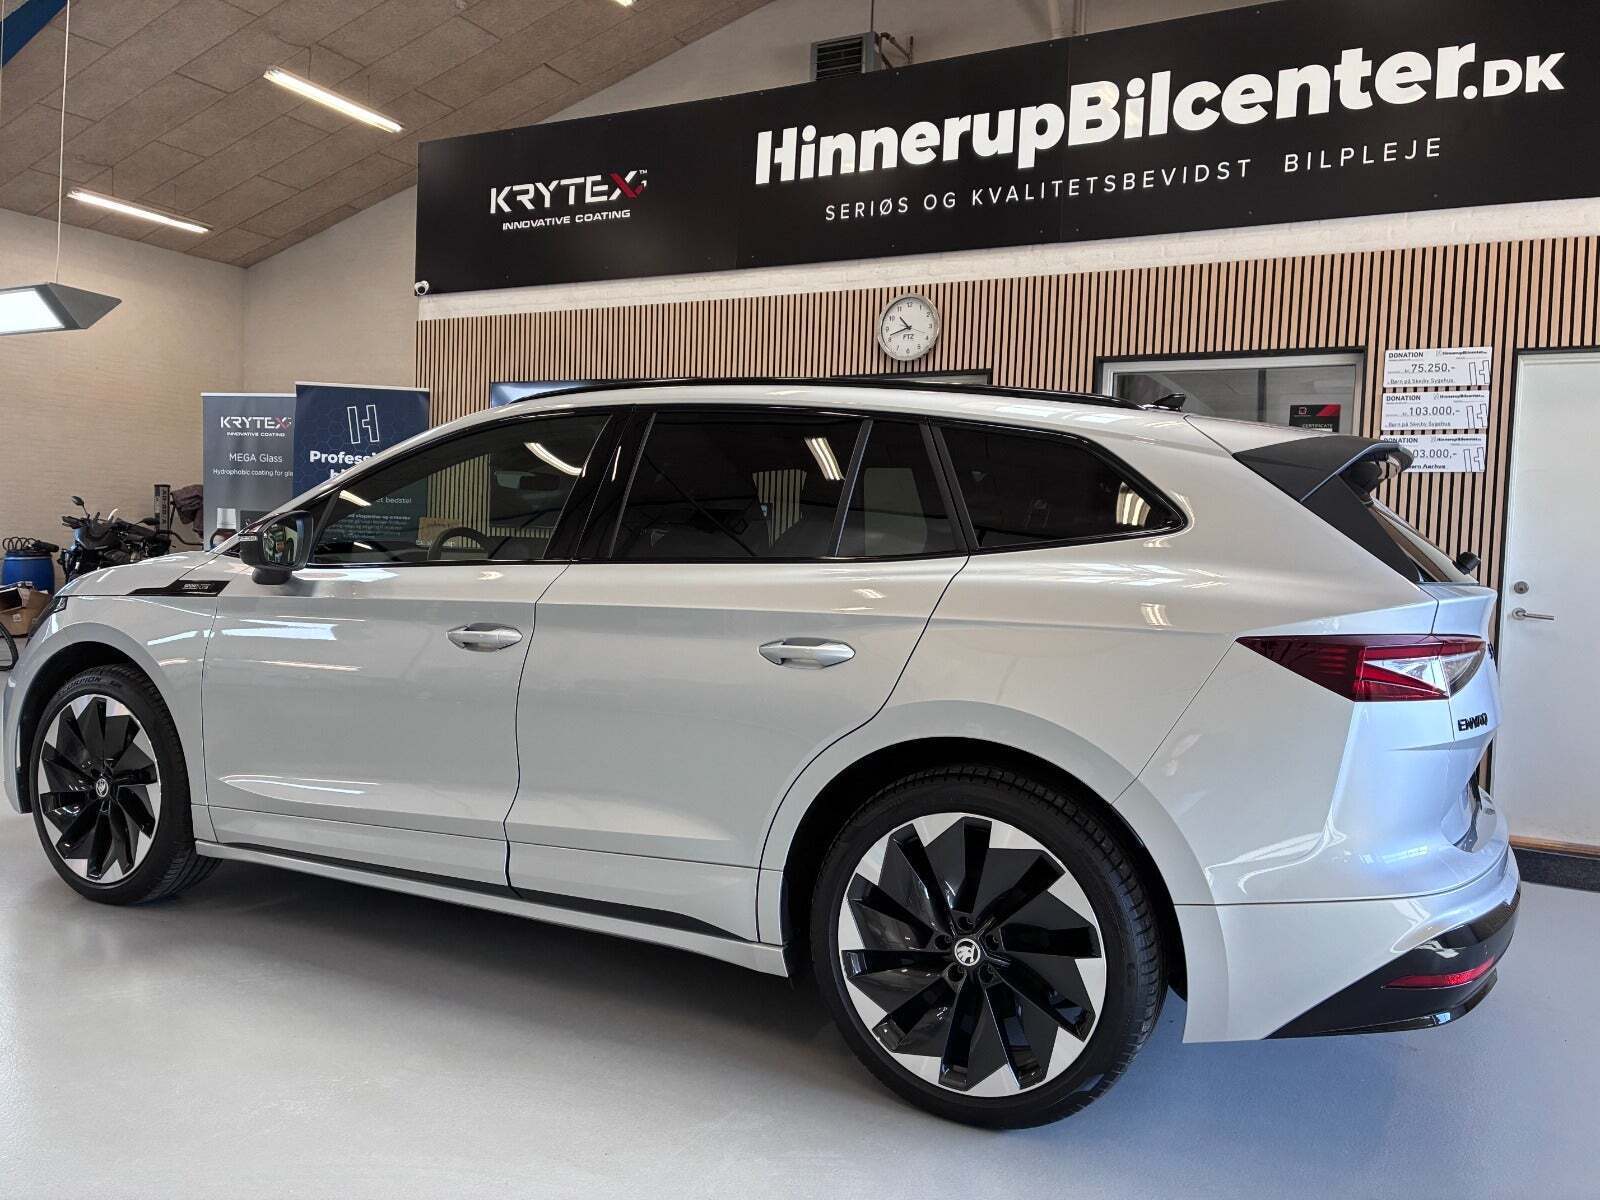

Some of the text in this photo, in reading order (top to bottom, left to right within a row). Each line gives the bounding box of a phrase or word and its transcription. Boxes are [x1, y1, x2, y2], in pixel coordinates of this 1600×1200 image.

[755, 42, 1565, 185] HinnerupBilcenter.DK
[825, 137, 1441, 221] SERIØS OG KVALITETSBEVIDST BILPLEJE
[490, 170, 647, 214] KRYTEX
[502, 209, 631, 231] INNOVATIVE COATING
[220, 416, 291, 431] KRYTEX
[229, 452, 283, 463] MEGA Glass
[1412, 448, 1457, 459] 03.000,-
[213, 468, 250, 476] Hydrophobic
[251, 469, 273, 477] coating
